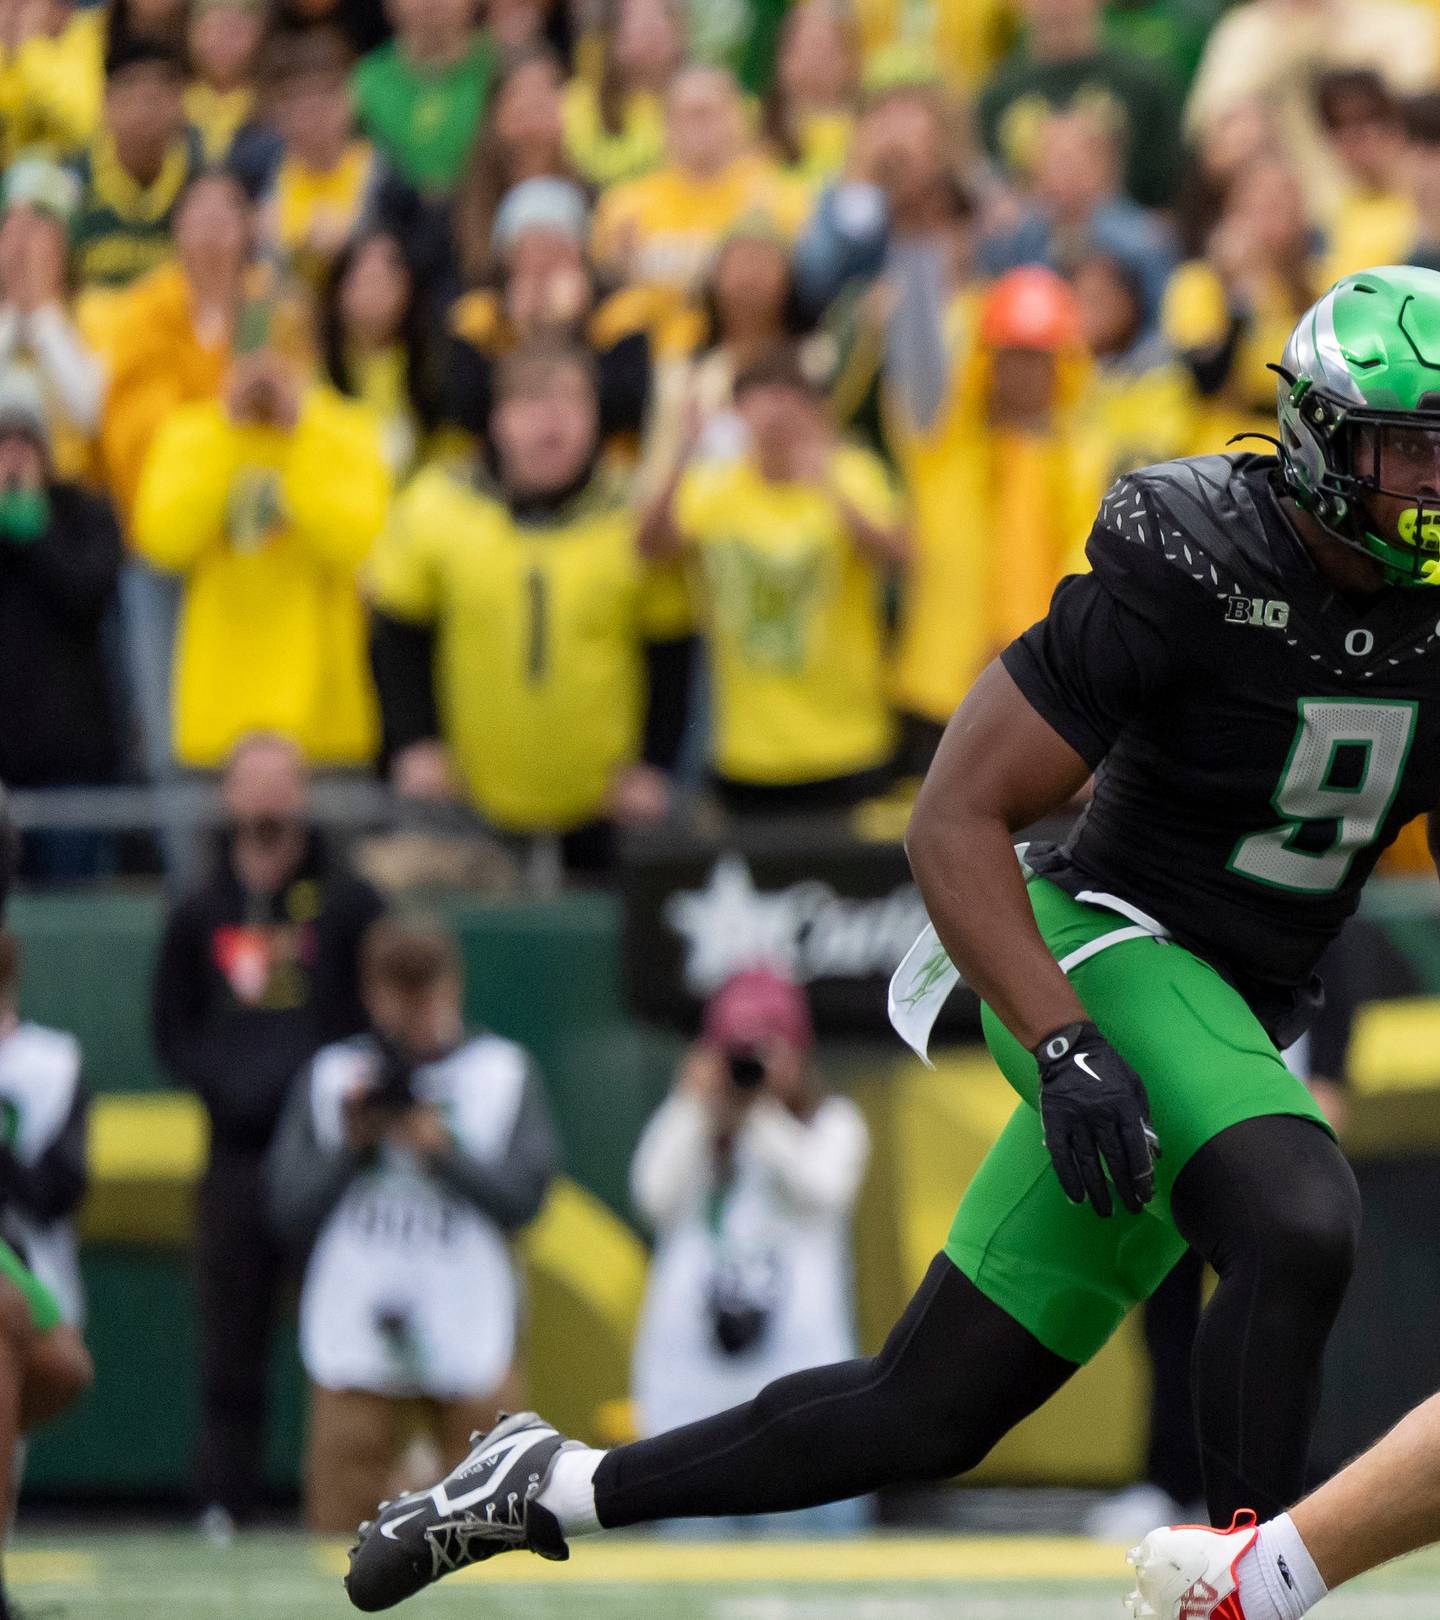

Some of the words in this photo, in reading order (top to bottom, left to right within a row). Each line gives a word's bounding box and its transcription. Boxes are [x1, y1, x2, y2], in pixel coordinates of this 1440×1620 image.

[1344, 629, 1374, 656] O
[1225, 697, 1419, 894] 9
[1046, 1036, 1069, 1059] O
